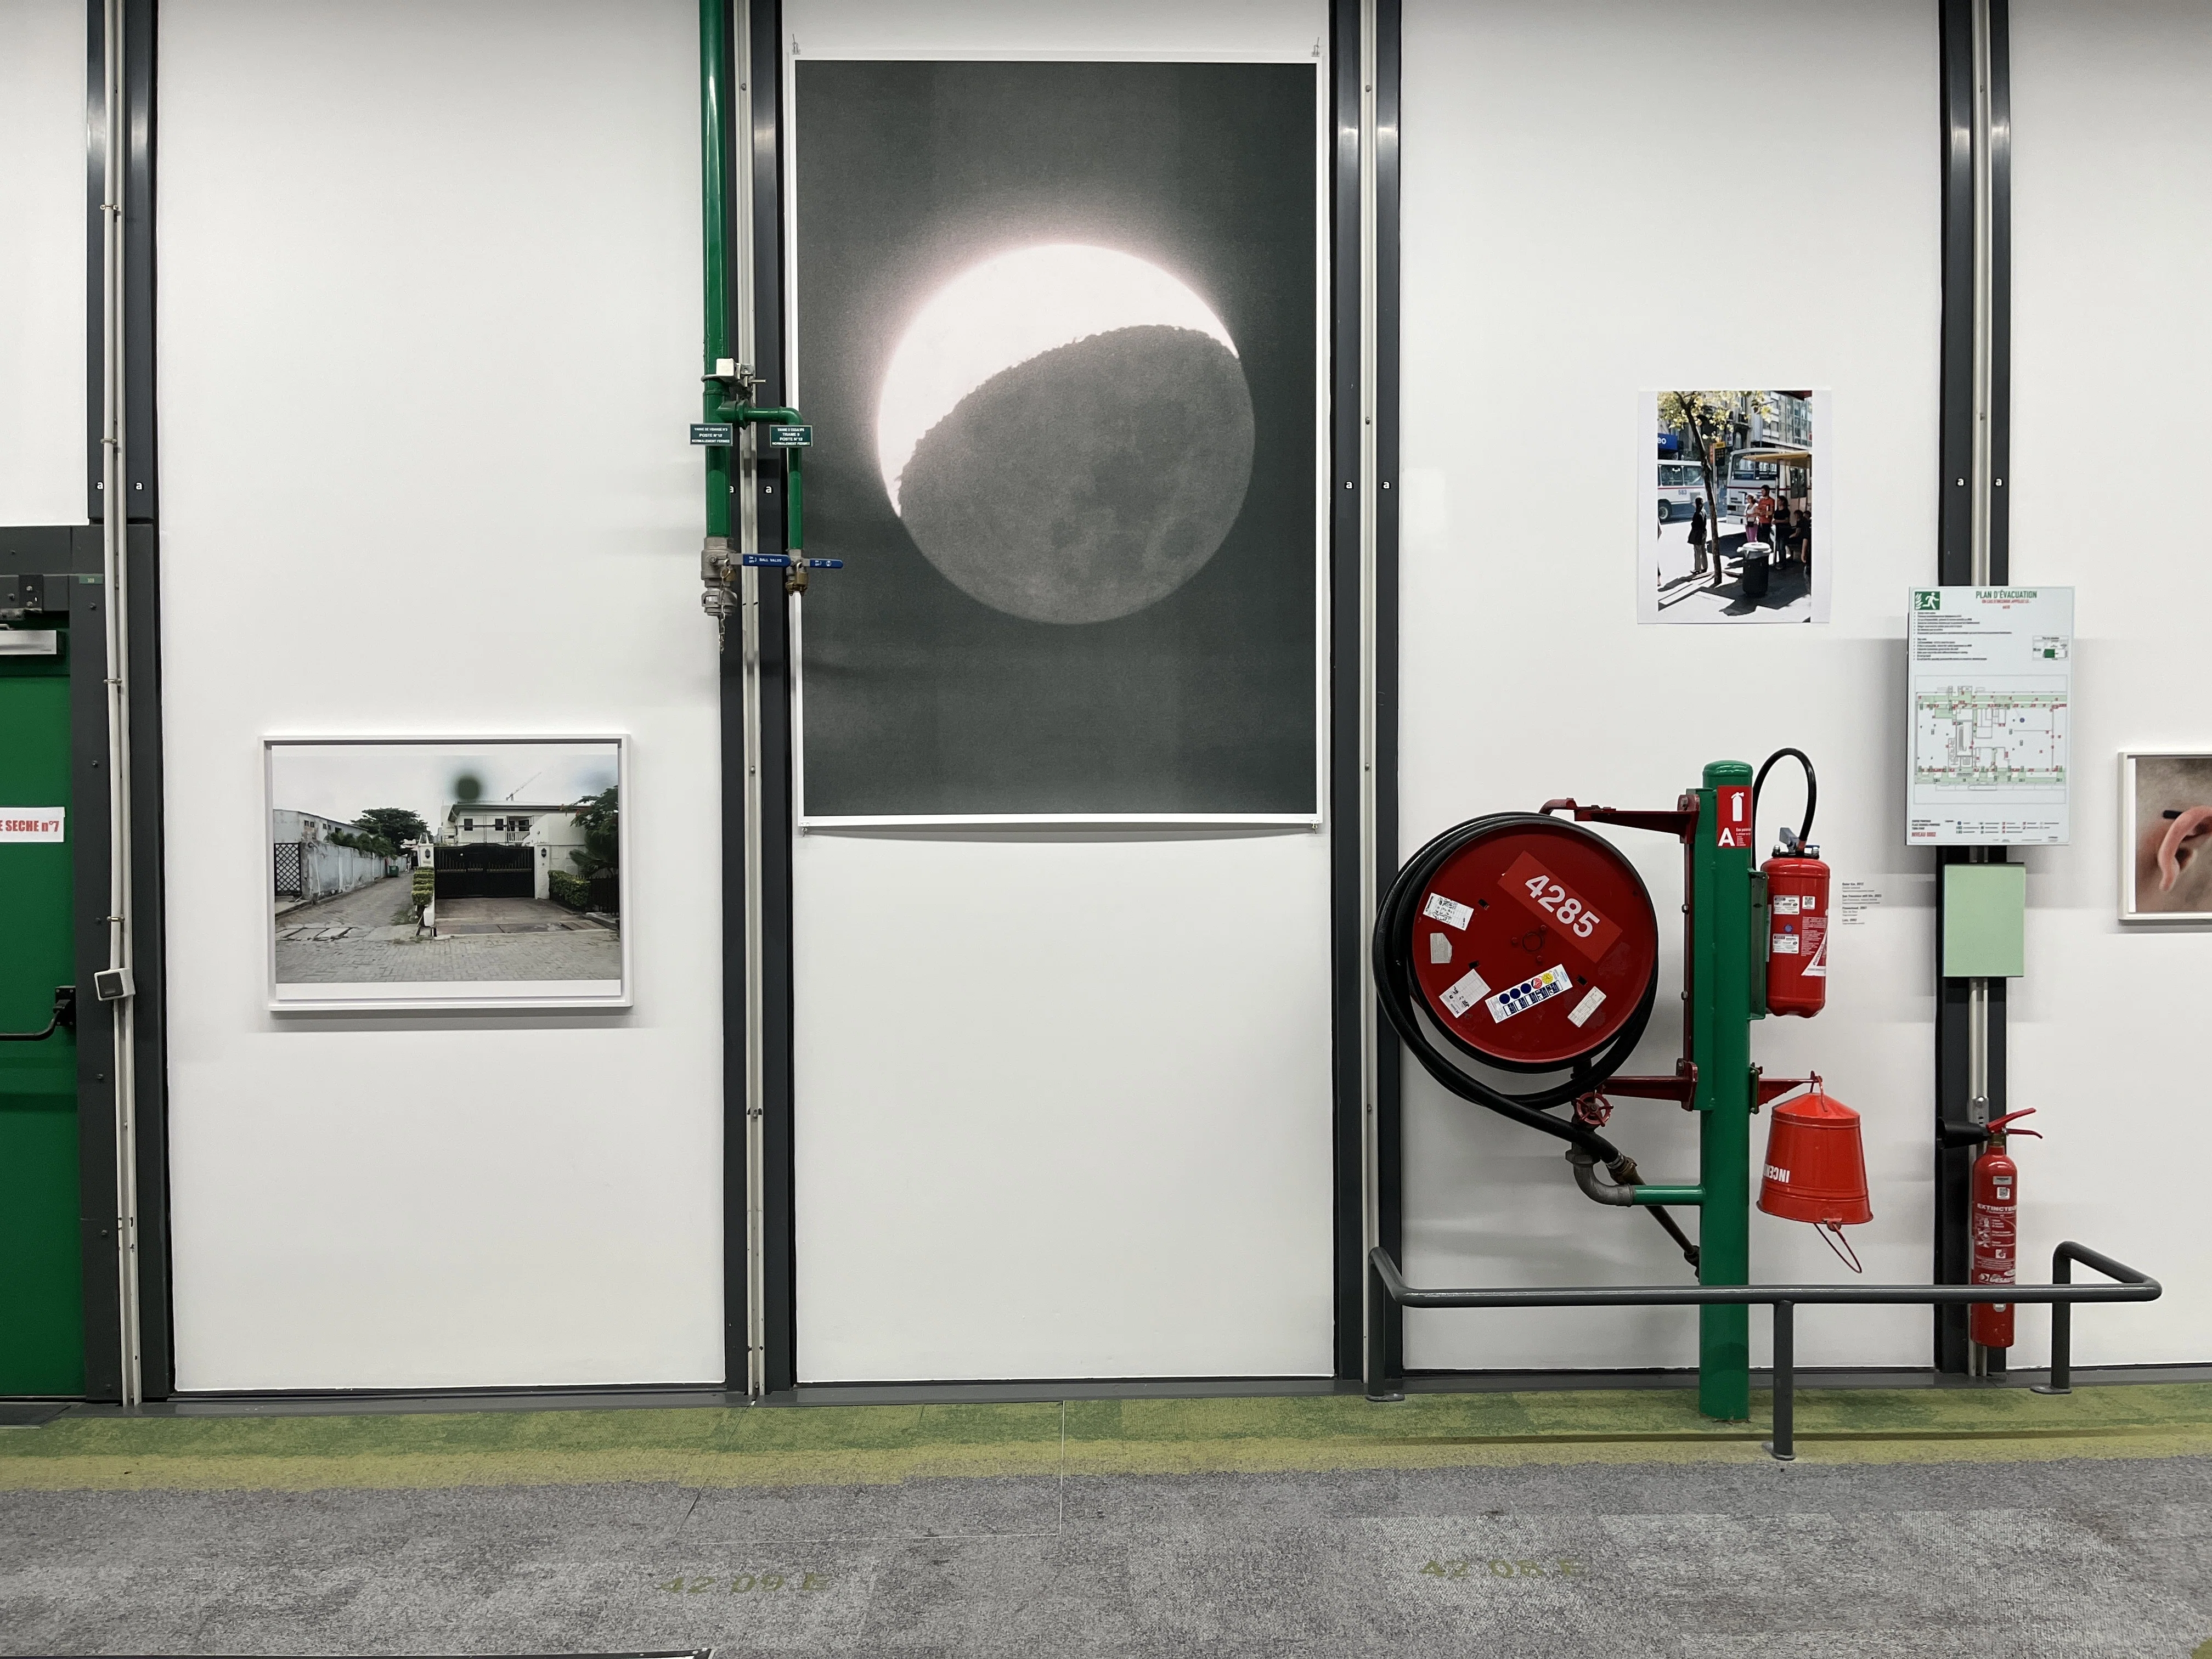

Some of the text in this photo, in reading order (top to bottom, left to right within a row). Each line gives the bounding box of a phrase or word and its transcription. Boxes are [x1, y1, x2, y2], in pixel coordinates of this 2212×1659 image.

[1994, 589, 2037, 599] D'ÉVACUATION
[5, 820, 39, 832] SECHE
[41, 821, 59, 832] n°7
[1718, 827, 1735, 847] A
[1525, 874, 1600, 938] 4285
[1419, 1559, 1470, 1578] 42
[660, 1575, 715, 1594] 42
